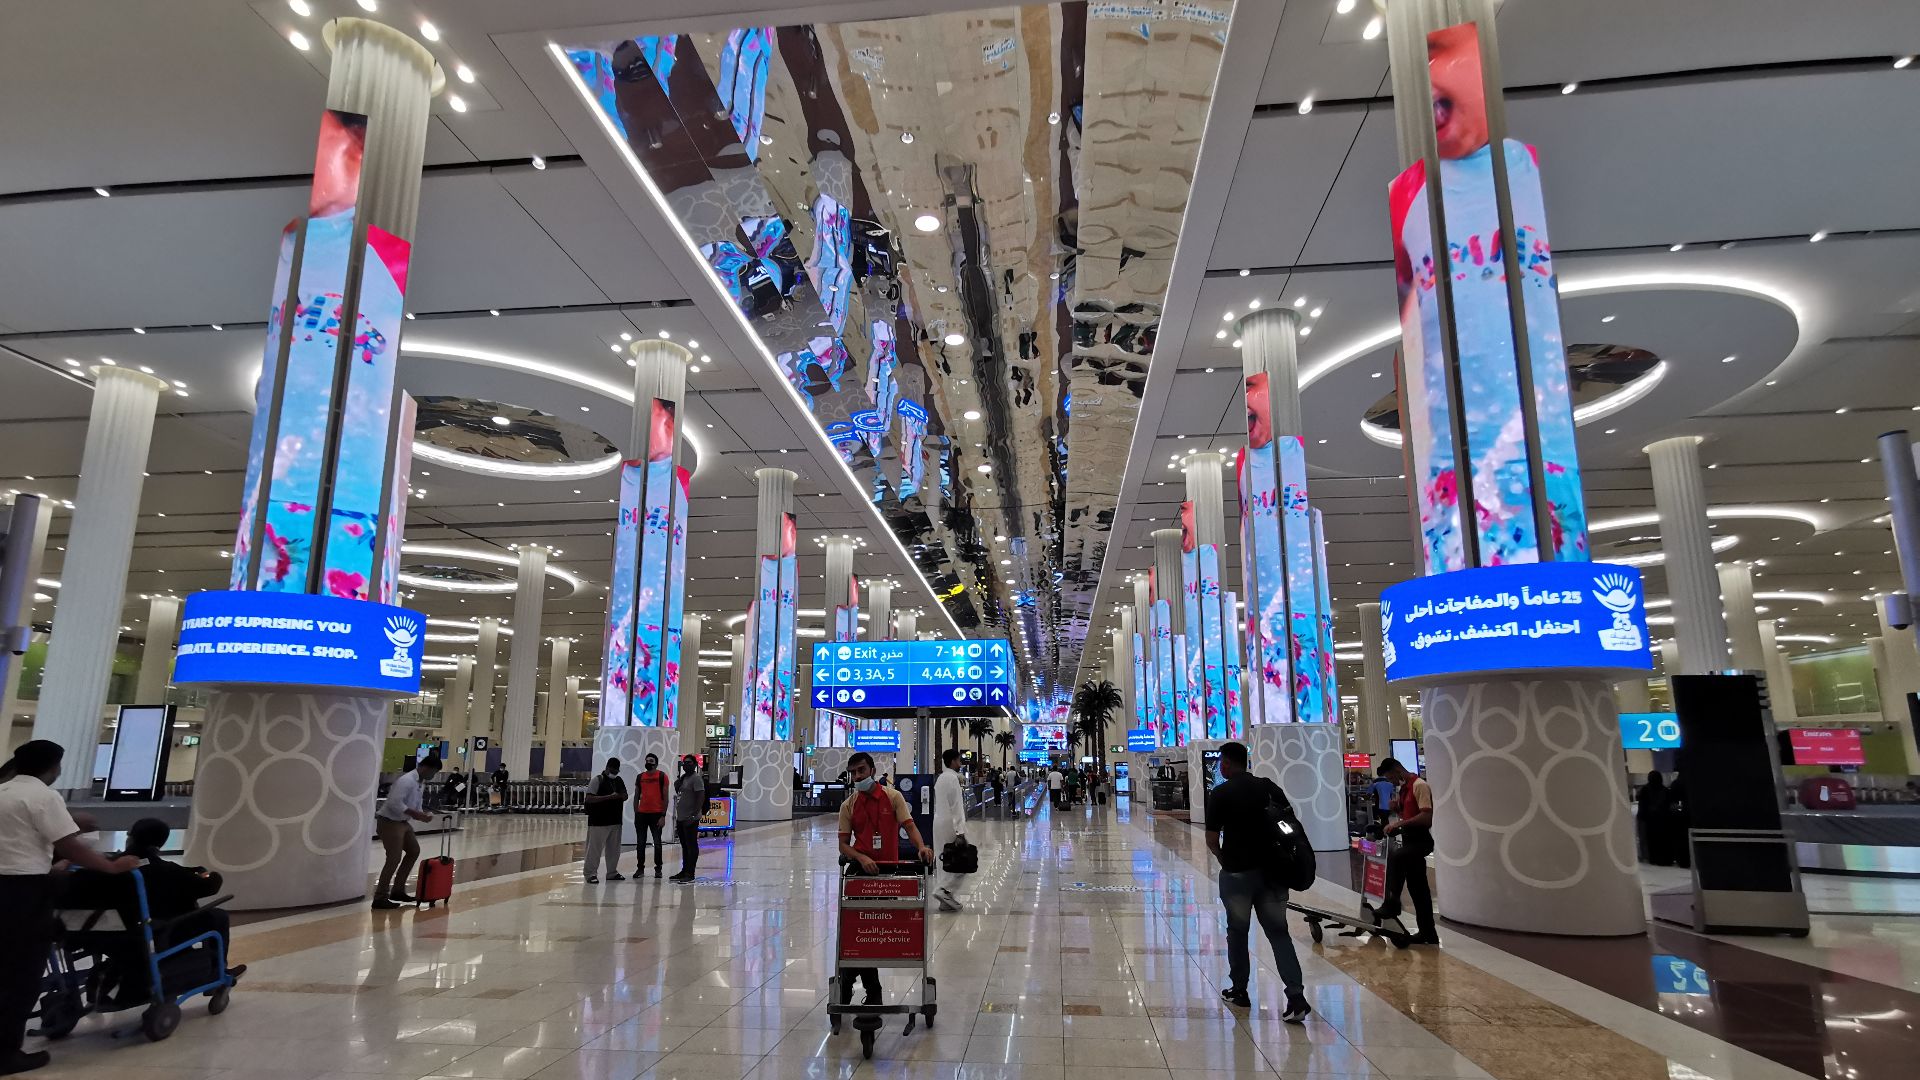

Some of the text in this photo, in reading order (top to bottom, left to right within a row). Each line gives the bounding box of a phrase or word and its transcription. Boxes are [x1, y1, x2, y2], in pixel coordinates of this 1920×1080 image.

[1561, 591, 1582, 604] 25
[215, 616, 233, 628] OF
[234, 616, 314, 631] SUPRISING
[317, 620, 352, 634] YOU
[216, 642, 310, 656] EXPERIENCE.
[313, 645, 358, 660] SHOP.
[854, 647, 877, 659] Exit
[880, 649, 904, 663] مخرج
[935, 645, 965, 657] 7-14
[887, 668, 895, 680] 5
[957, 666, 965, 679] 6
[1637, 719, 1654, 742] 2
[859, 911, 893, 920] Emirates
[855, 935, 911, 944] Concierge Service
